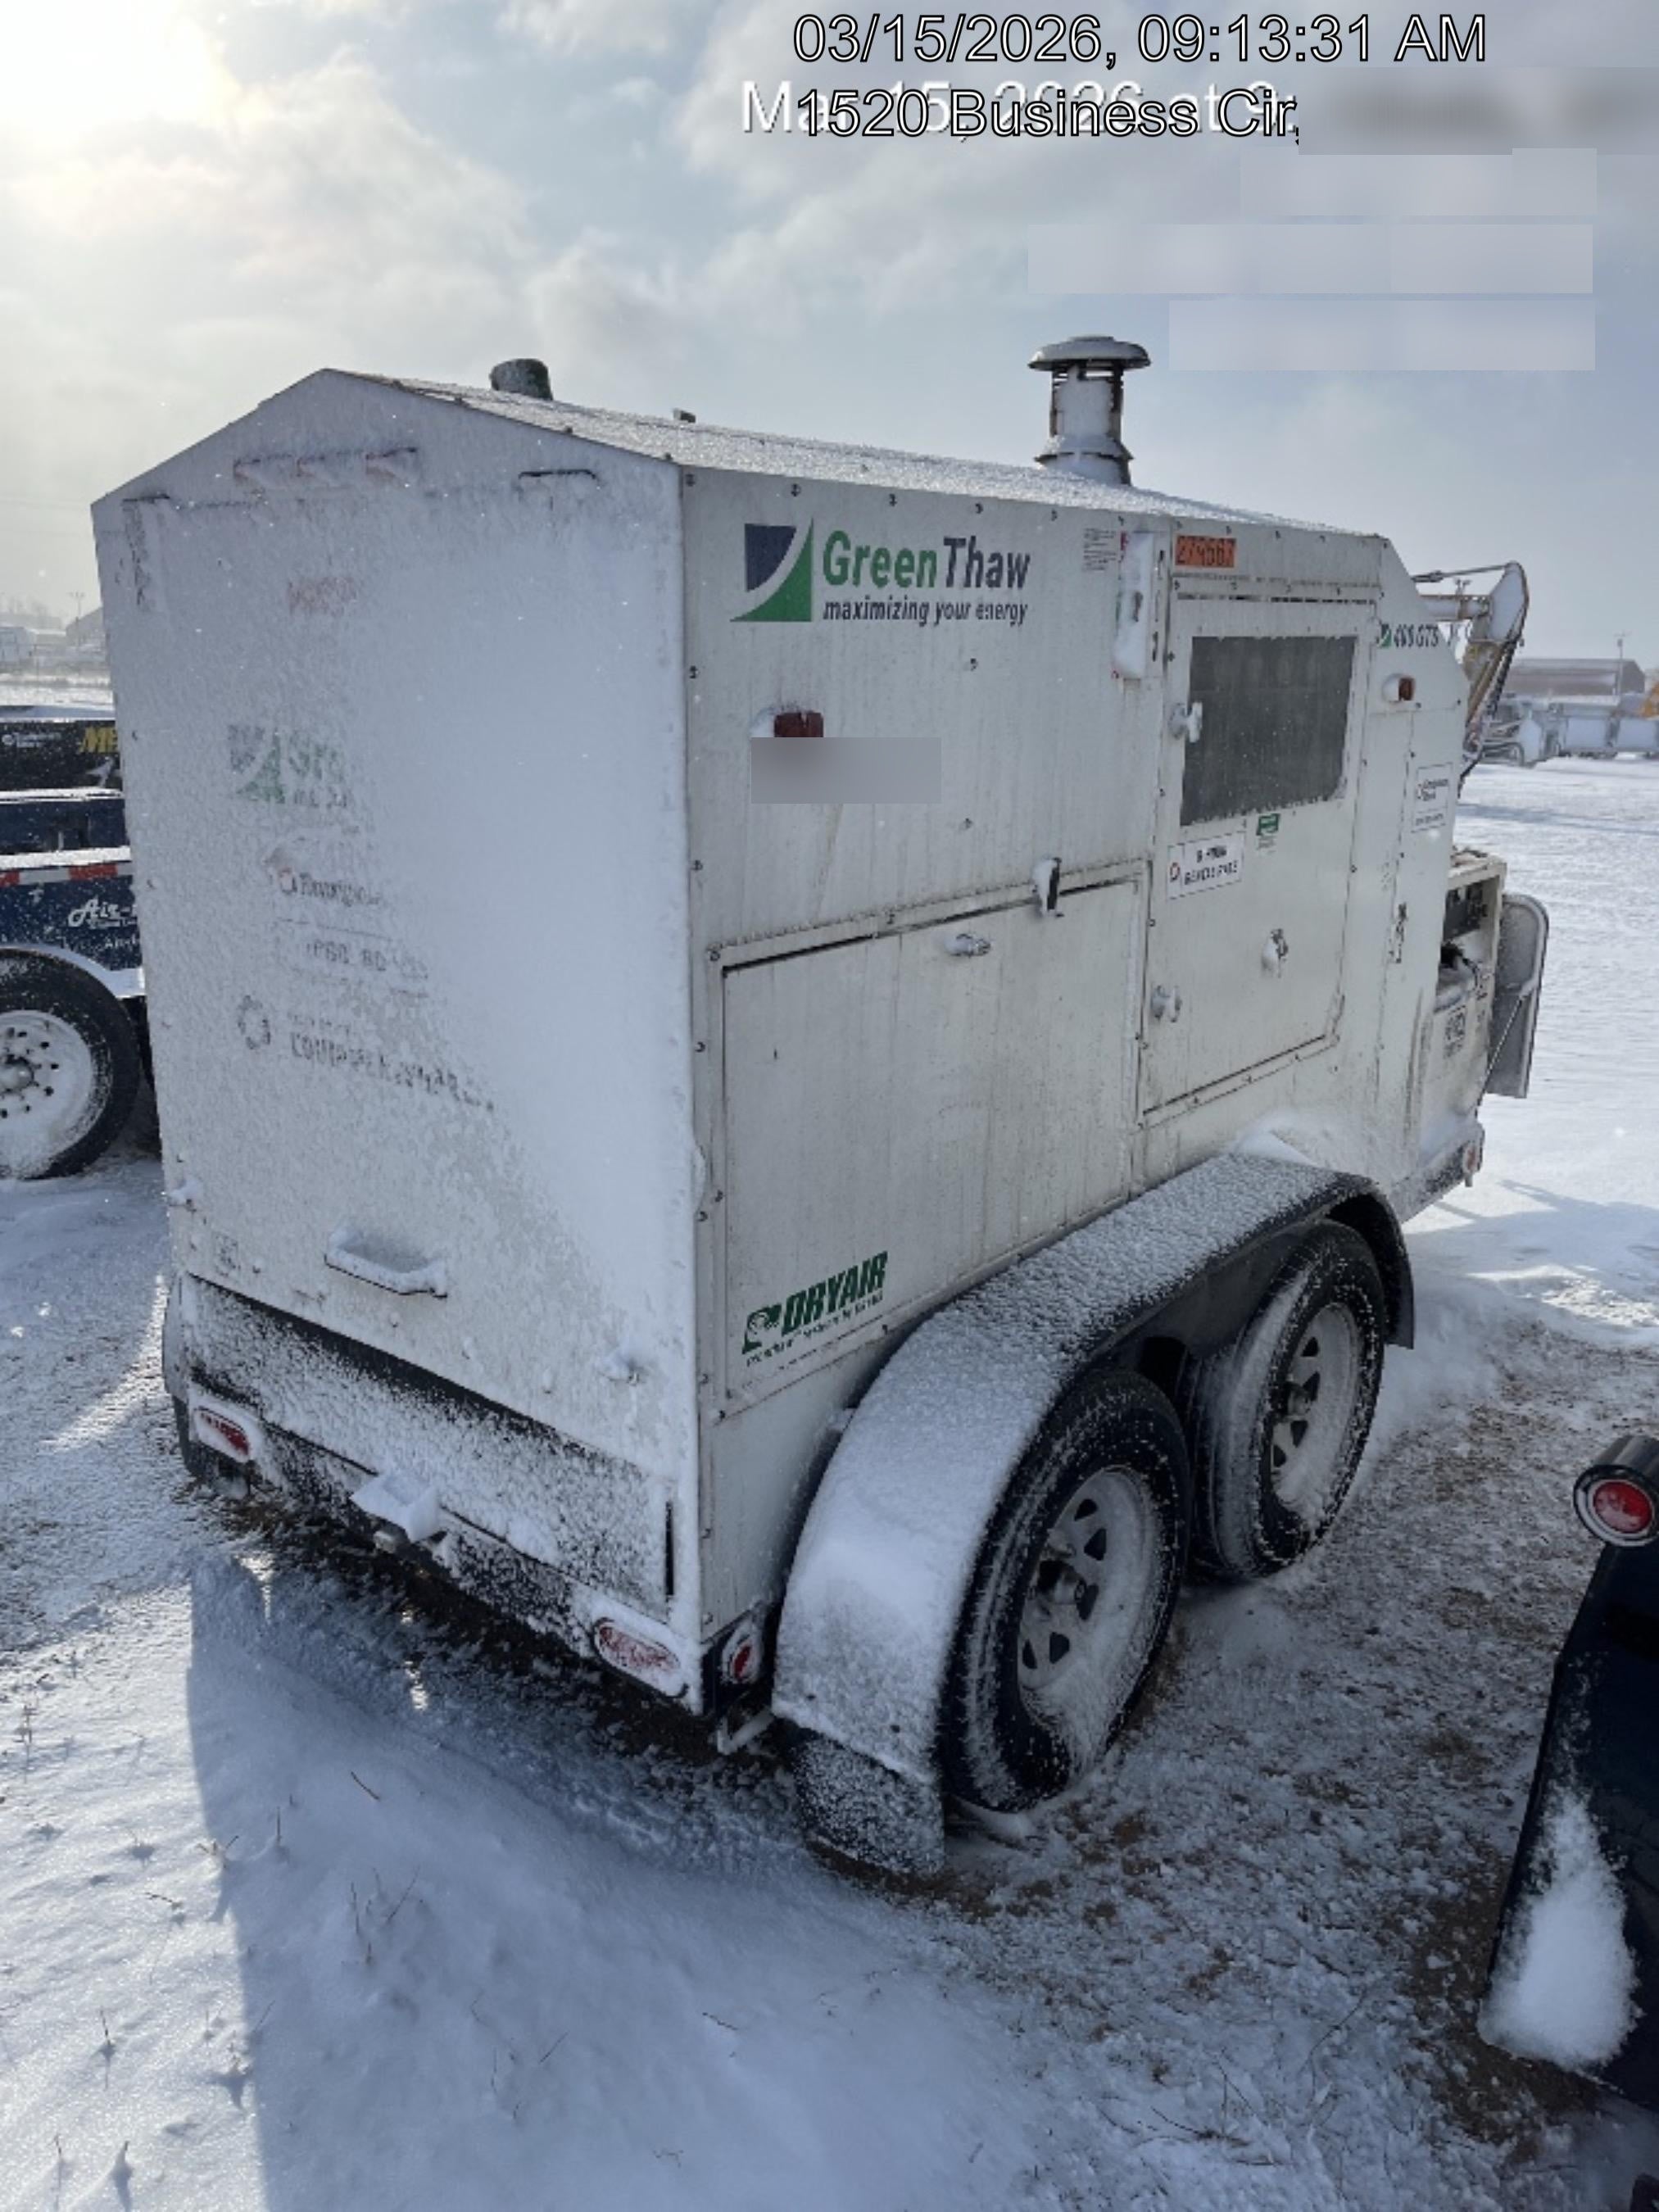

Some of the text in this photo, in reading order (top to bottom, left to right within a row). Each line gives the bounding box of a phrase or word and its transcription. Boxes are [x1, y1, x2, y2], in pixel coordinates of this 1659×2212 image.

[823, 529, 1031, 590] GreenThaw
[823, 594, 1029, 628] maximizing your energy
[781, 1251, 888, 1336] DRYAIR
